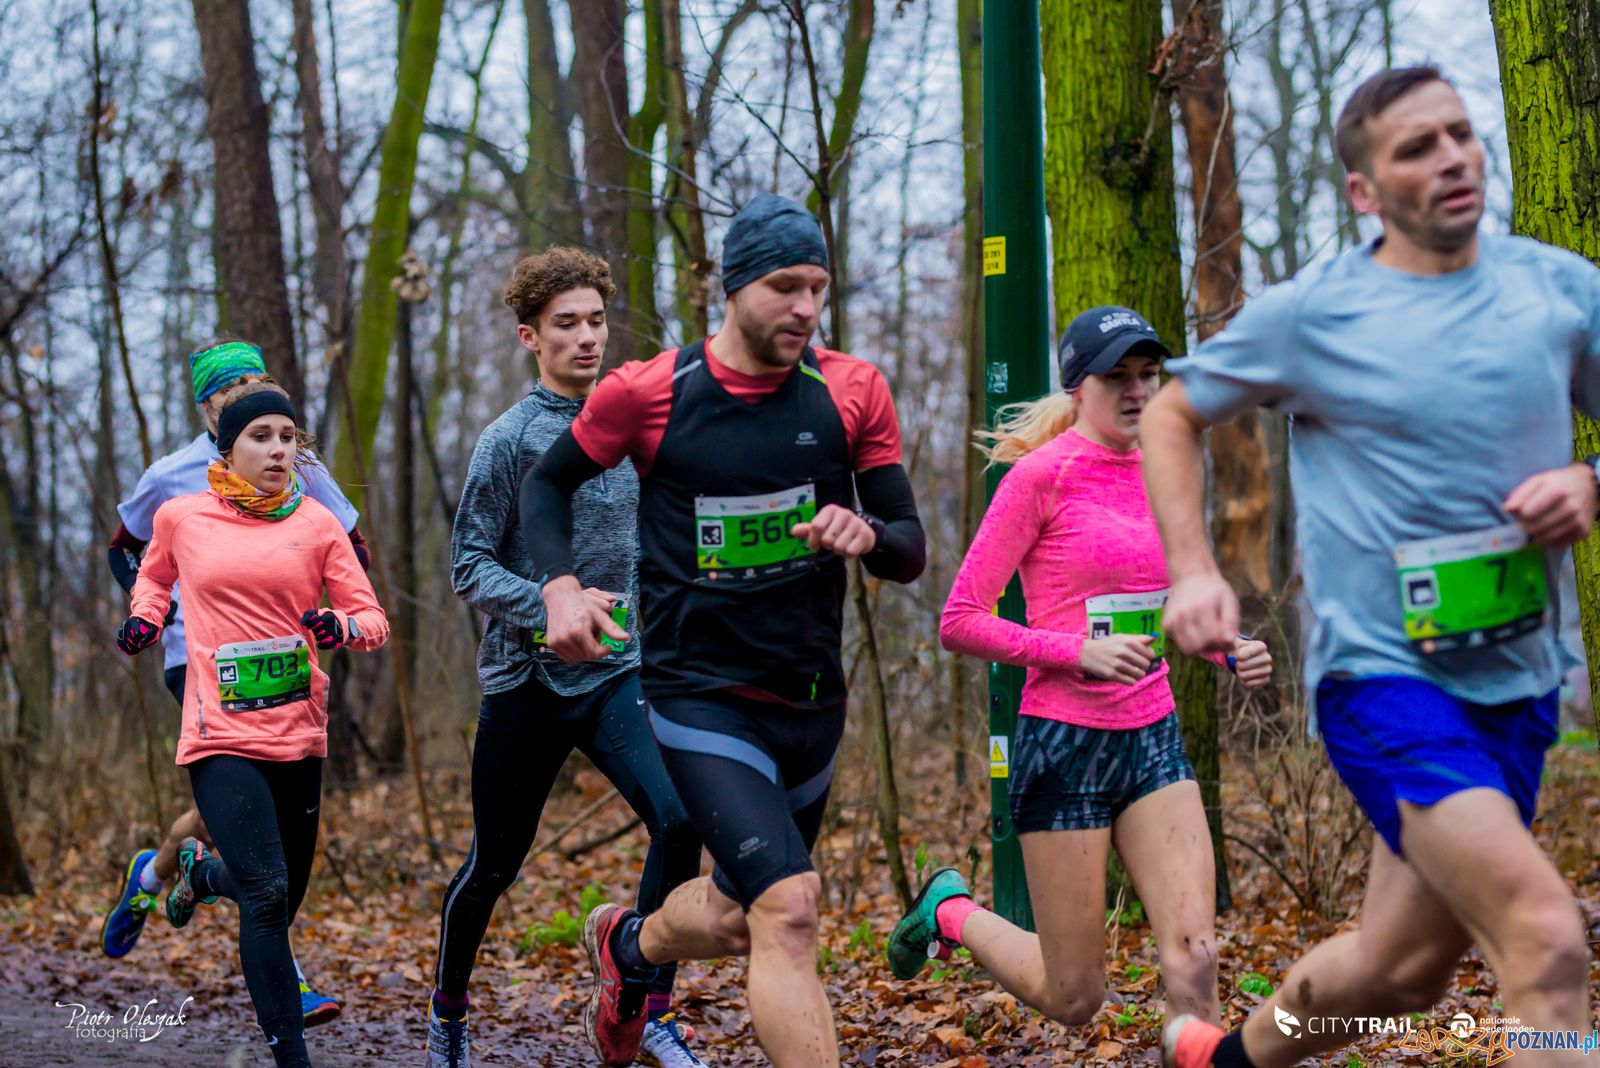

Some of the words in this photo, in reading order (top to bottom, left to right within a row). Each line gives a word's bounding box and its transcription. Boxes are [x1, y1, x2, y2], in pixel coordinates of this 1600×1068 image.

[740, 511, 803, 548] 560
[1486, 557, 1508, 596] 7
[248, 652, 299, 682] 703
